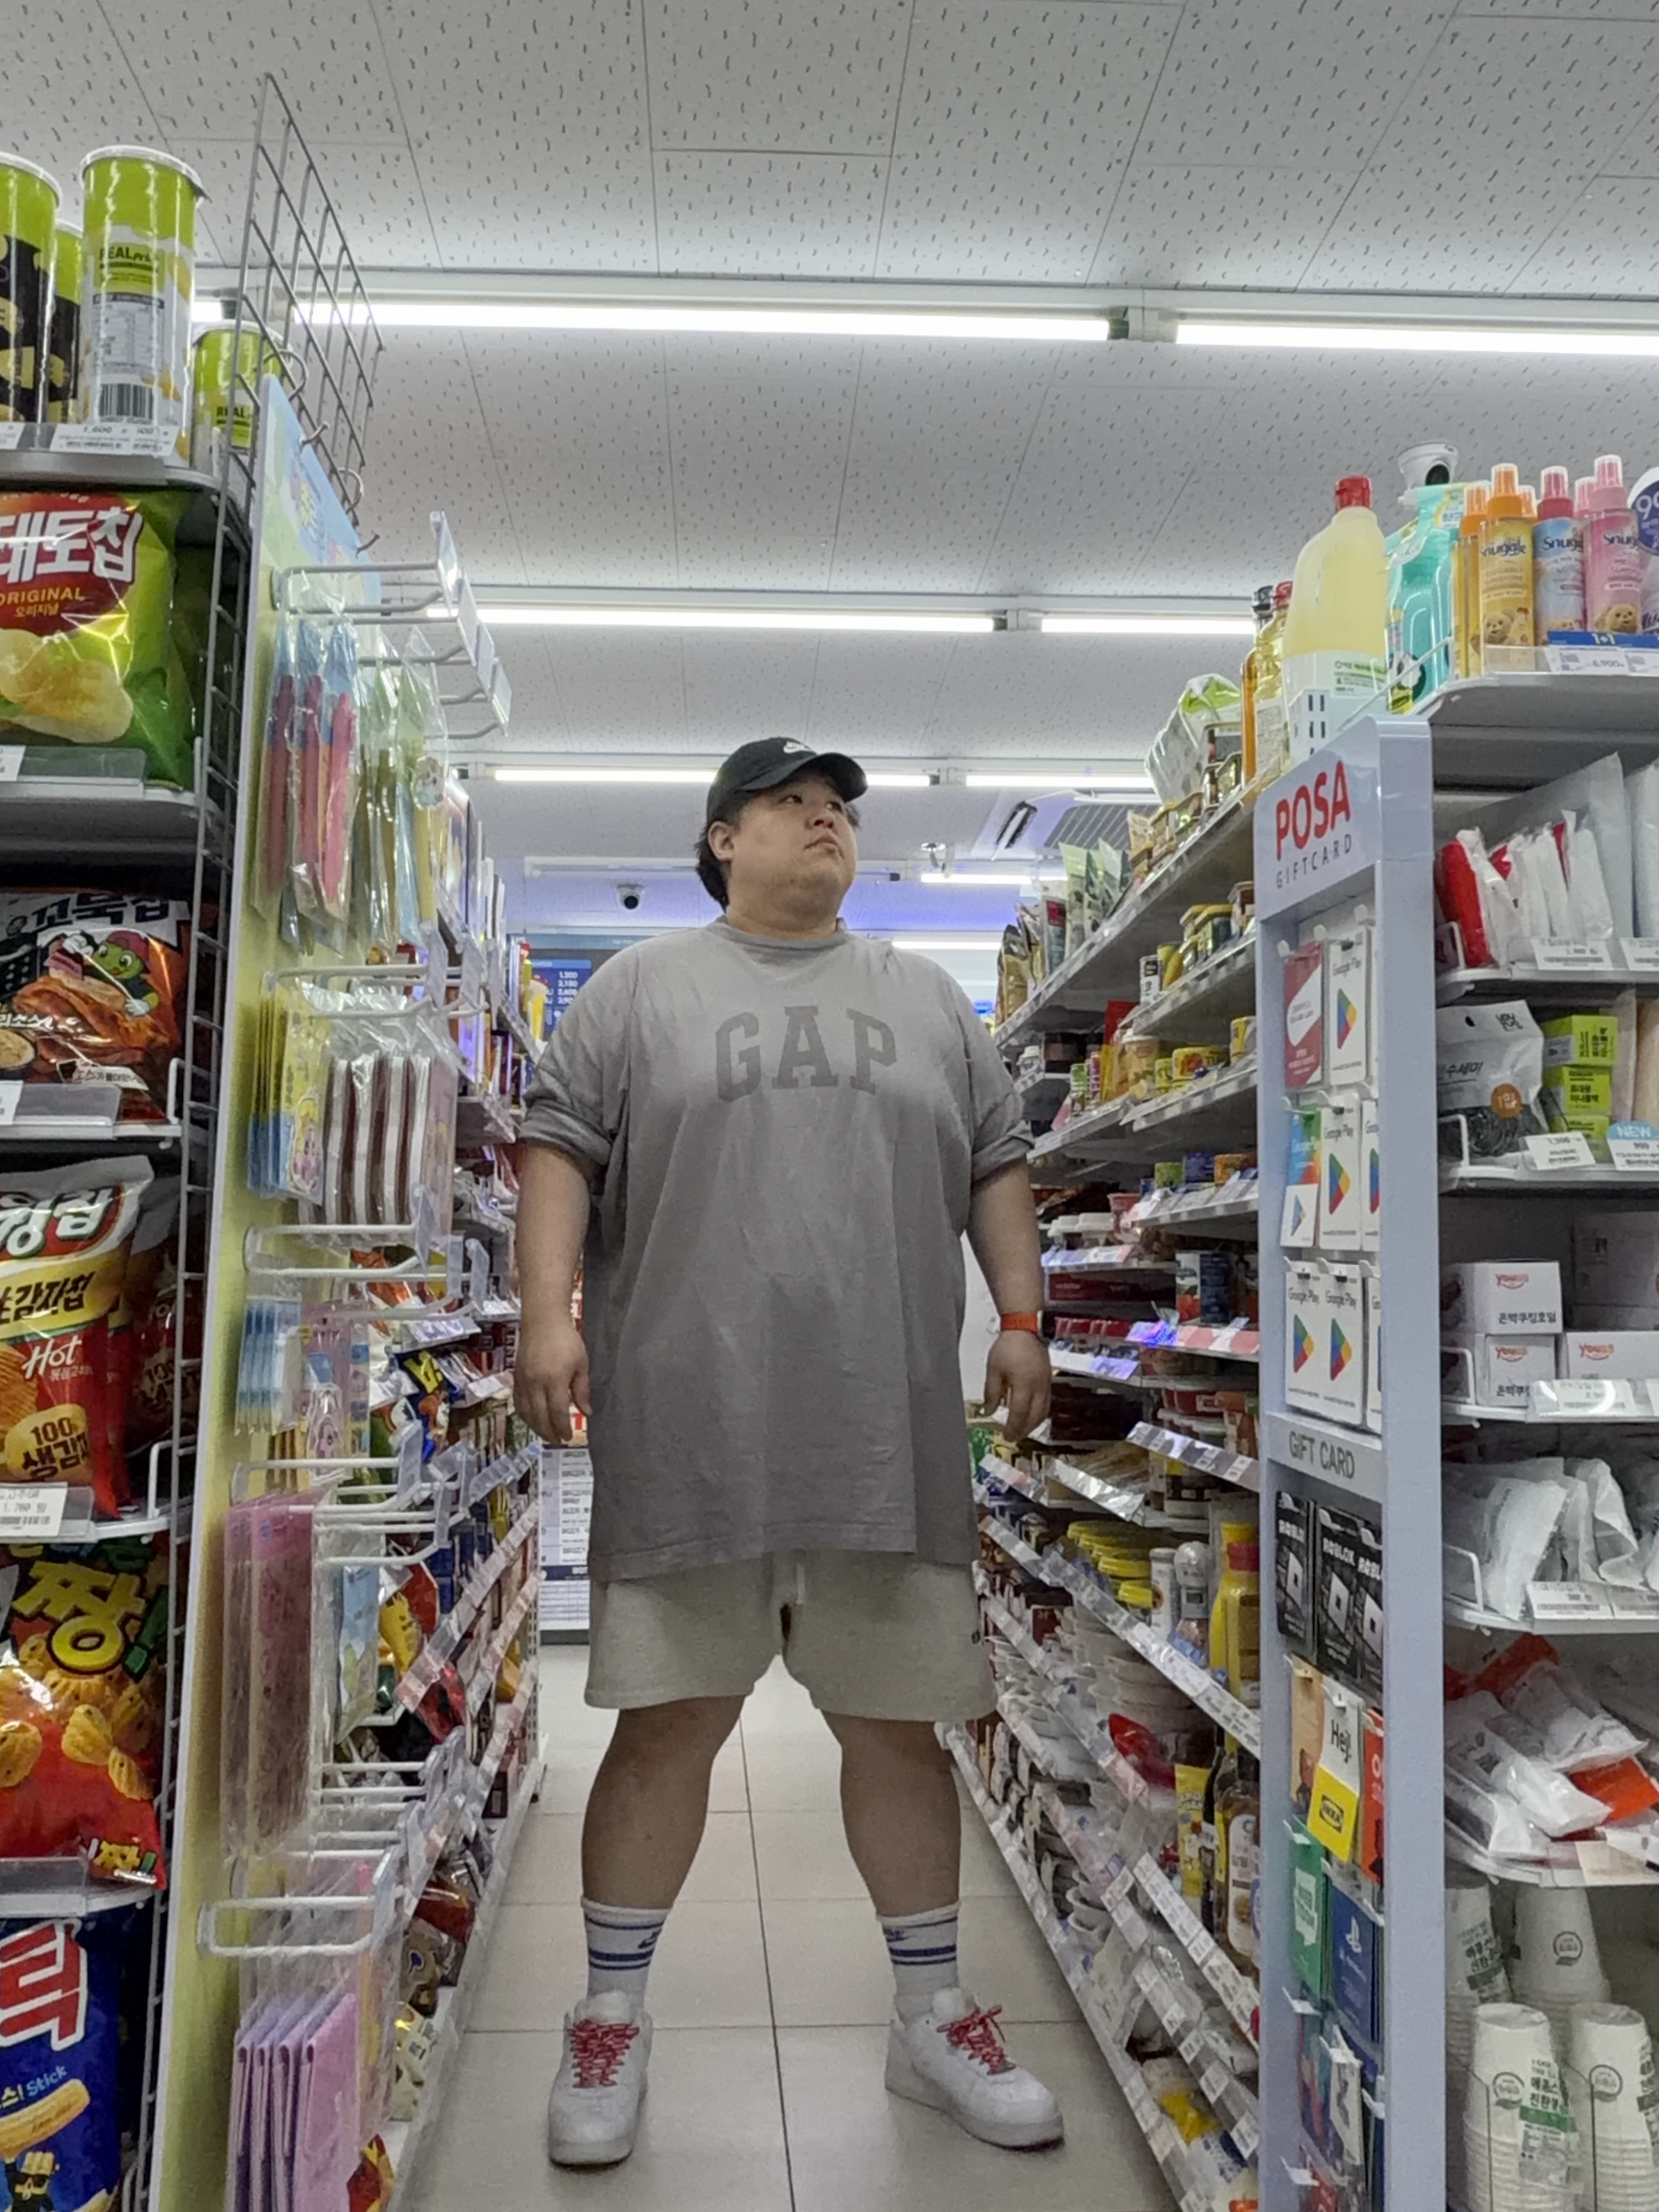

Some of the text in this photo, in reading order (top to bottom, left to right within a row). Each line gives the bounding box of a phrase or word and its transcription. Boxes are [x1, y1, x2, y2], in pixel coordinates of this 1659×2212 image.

[1592, 633, 1616, 645] 1+1
[1276, 760, 1351, 861] POSA
[715, 1005, 897, 1102] GAP
[1616, 1125, 1652, 1138] NEW
[21, 1335, 82, 1380] Hot
[30, 1417, 73, 1447] 100
[1289, 1431, 1355, 1480] GIFT CARD
[1321, 1800, 1343, 1824] IKEA
[26, 2065, 68, 2098] Stick
